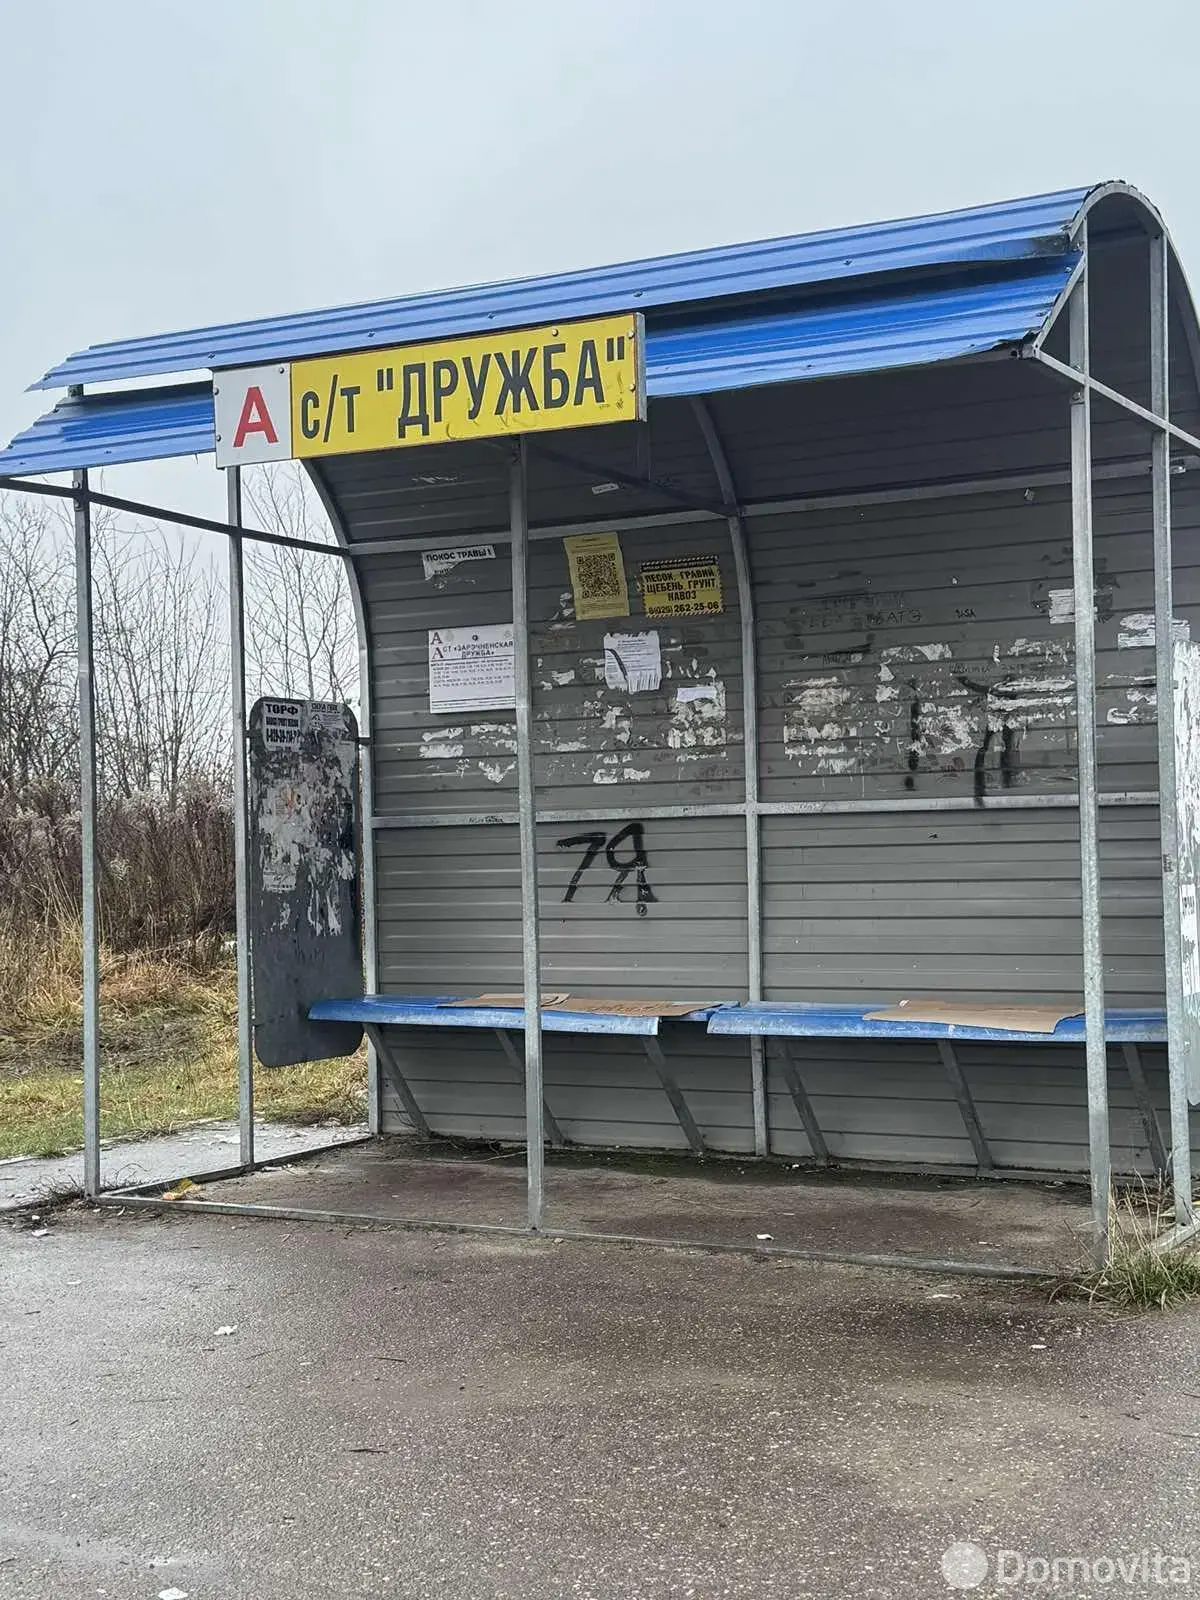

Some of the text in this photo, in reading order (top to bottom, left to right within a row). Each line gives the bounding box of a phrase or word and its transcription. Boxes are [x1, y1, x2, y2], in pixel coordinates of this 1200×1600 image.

[233, 386, 279, 448] А
[377, 335, 625, 439] "ДРУЖБА"
[426, 552, 456, 562] ПОКОС
[687, 578, 716, 590] ГРУНТ
[667, 590, 697, 602] НАВОЗ
[265, 703, 299, 715] ТОРФ
